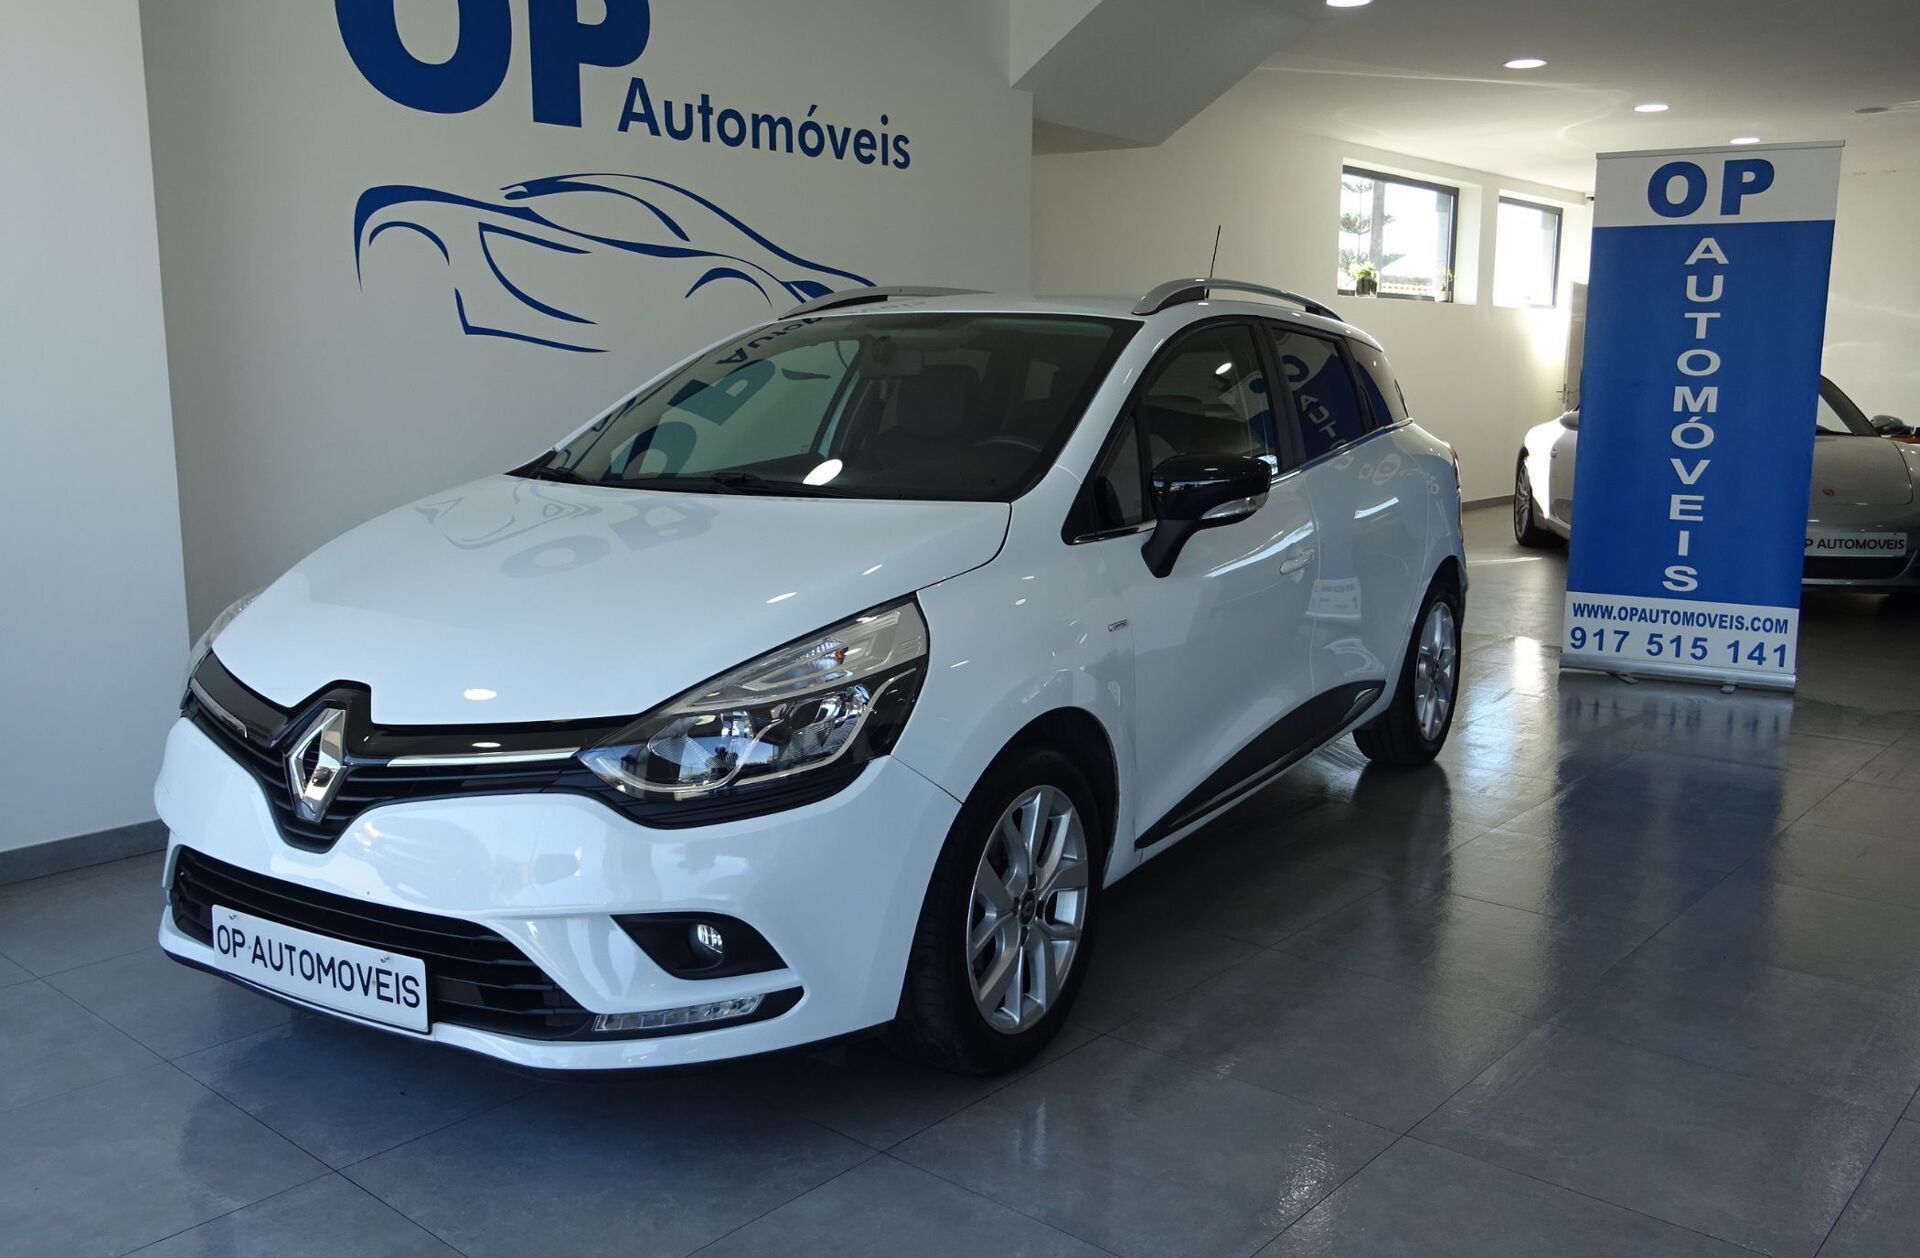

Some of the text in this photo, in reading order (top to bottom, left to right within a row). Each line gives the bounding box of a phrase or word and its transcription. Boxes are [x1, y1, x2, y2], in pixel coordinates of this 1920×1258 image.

[334, 0, 650, 128] OP
[617, 77, 911, 170] Automóveis
[1647, 158, 1775, 218] OP
[1661, 237, 1730, 593] AUTOMÓVEIS
[1817, 538, 1905, 550] AUTOMOVEIS
[1570, 626, 1787, 668] 917 515 141
[1572, 602, 1788, 634] WWW.OPAUTOMOVEIS.COM
[217, 924, 421, 1009] OP AUTOMOVEIS
